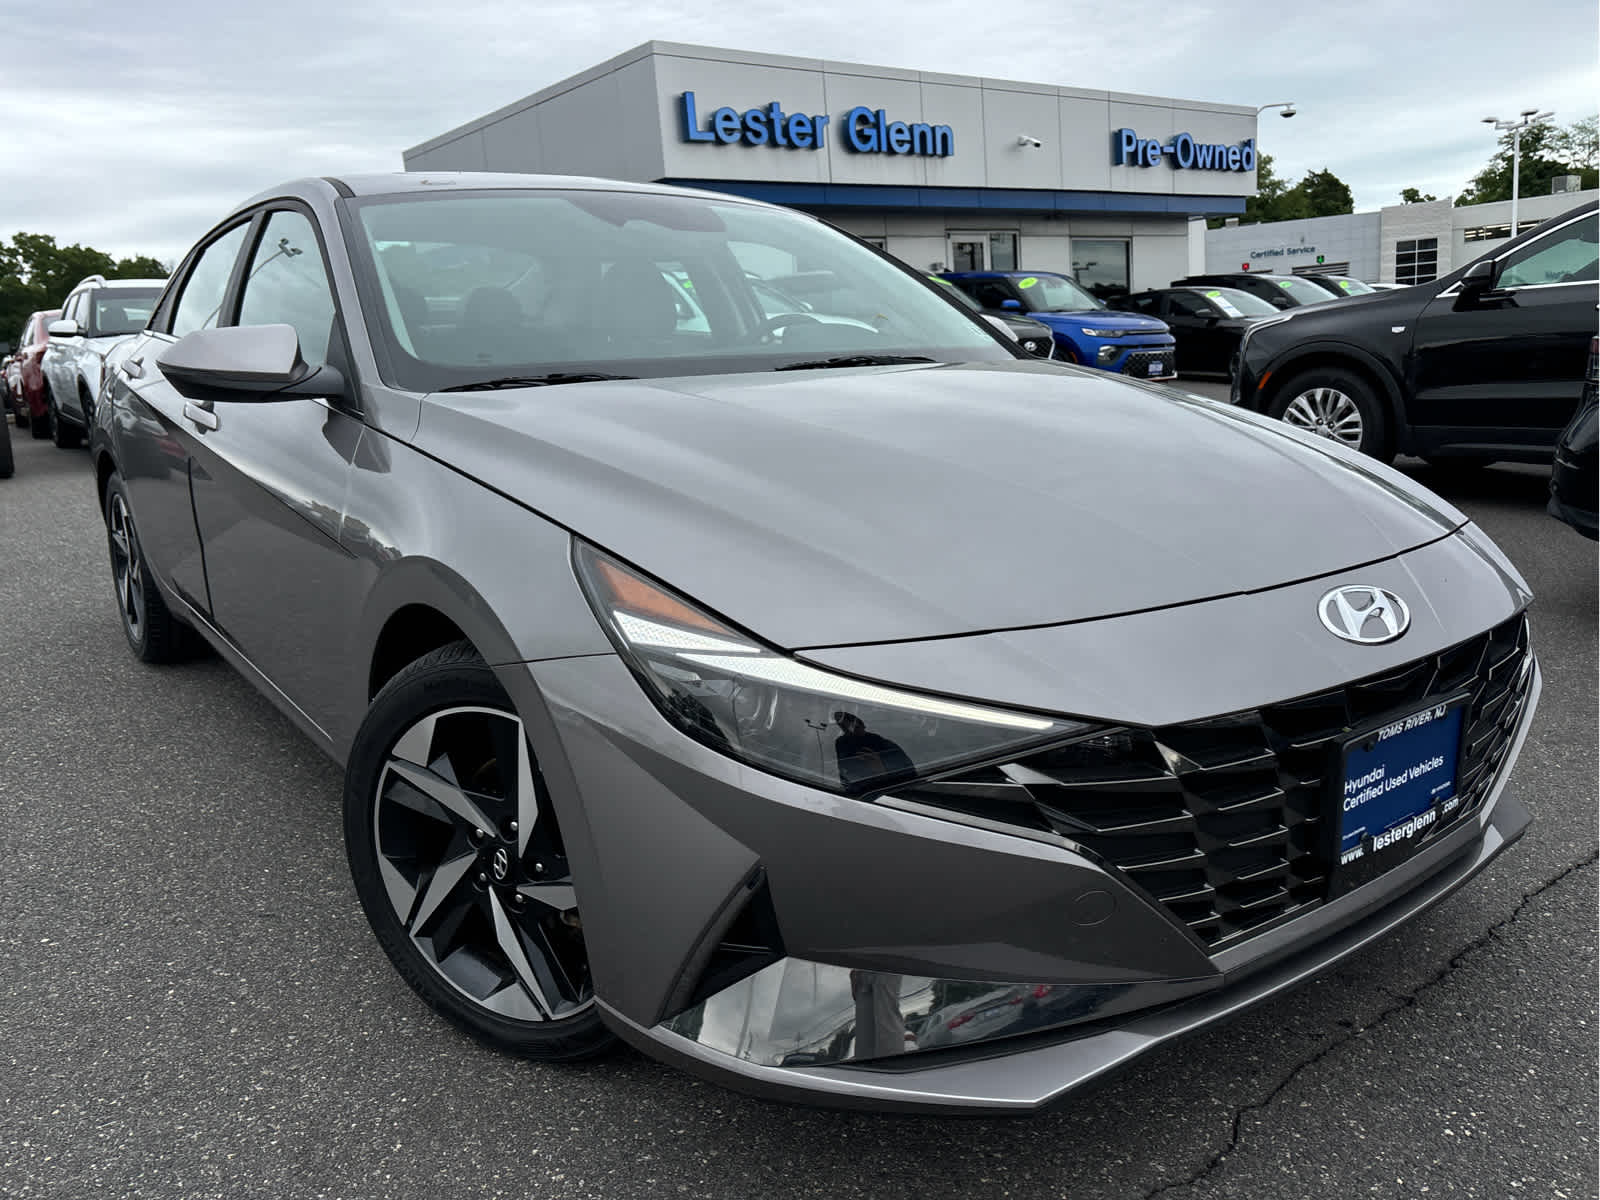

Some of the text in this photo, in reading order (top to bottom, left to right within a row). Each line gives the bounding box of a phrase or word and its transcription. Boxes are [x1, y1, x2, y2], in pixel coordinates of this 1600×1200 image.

[680, 91, 954, 157] Lester Glenn
[1114, 128, 1255, 172] Pre-Owned
[1250, 246, 1316, 259] Certified Service
[1377, 722, 1404, 742] TOMS
[1433, 705, 1447, 721] NJ
[1343, 785, 1384, 812] Certified
[1385, 771, 1408, 792] Used
[1409, 755, 1444, 780] Vehicles
[1344, 764, 1385, 795] Hyundai
[1340, 847, 1365, 865] www.
[1372, 810, 1436, 852] lesterglenn
[1441, 797, 1459, 815] .com
